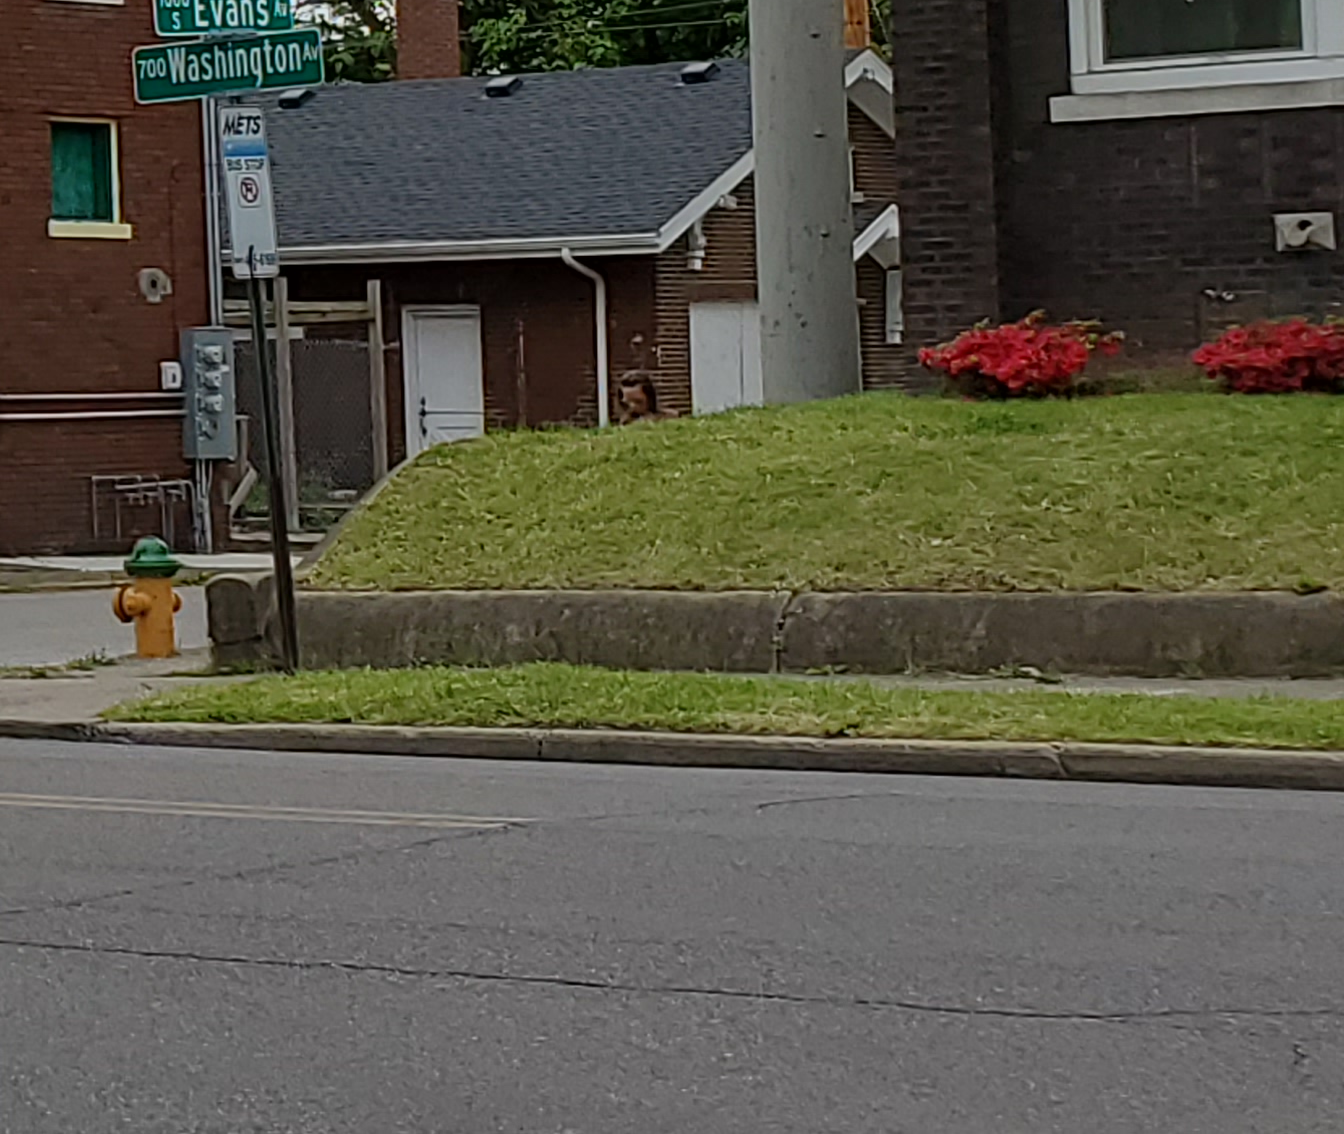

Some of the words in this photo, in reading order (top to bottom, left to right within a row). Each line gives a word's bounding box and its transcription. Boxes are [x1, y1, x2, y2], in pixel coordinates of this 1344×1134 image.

[172, 11, 181, 30] S
[137, 58, 167, 80] 700
[167, 37, 302, 88] Washington
[222, 115, 261, 136] METS
